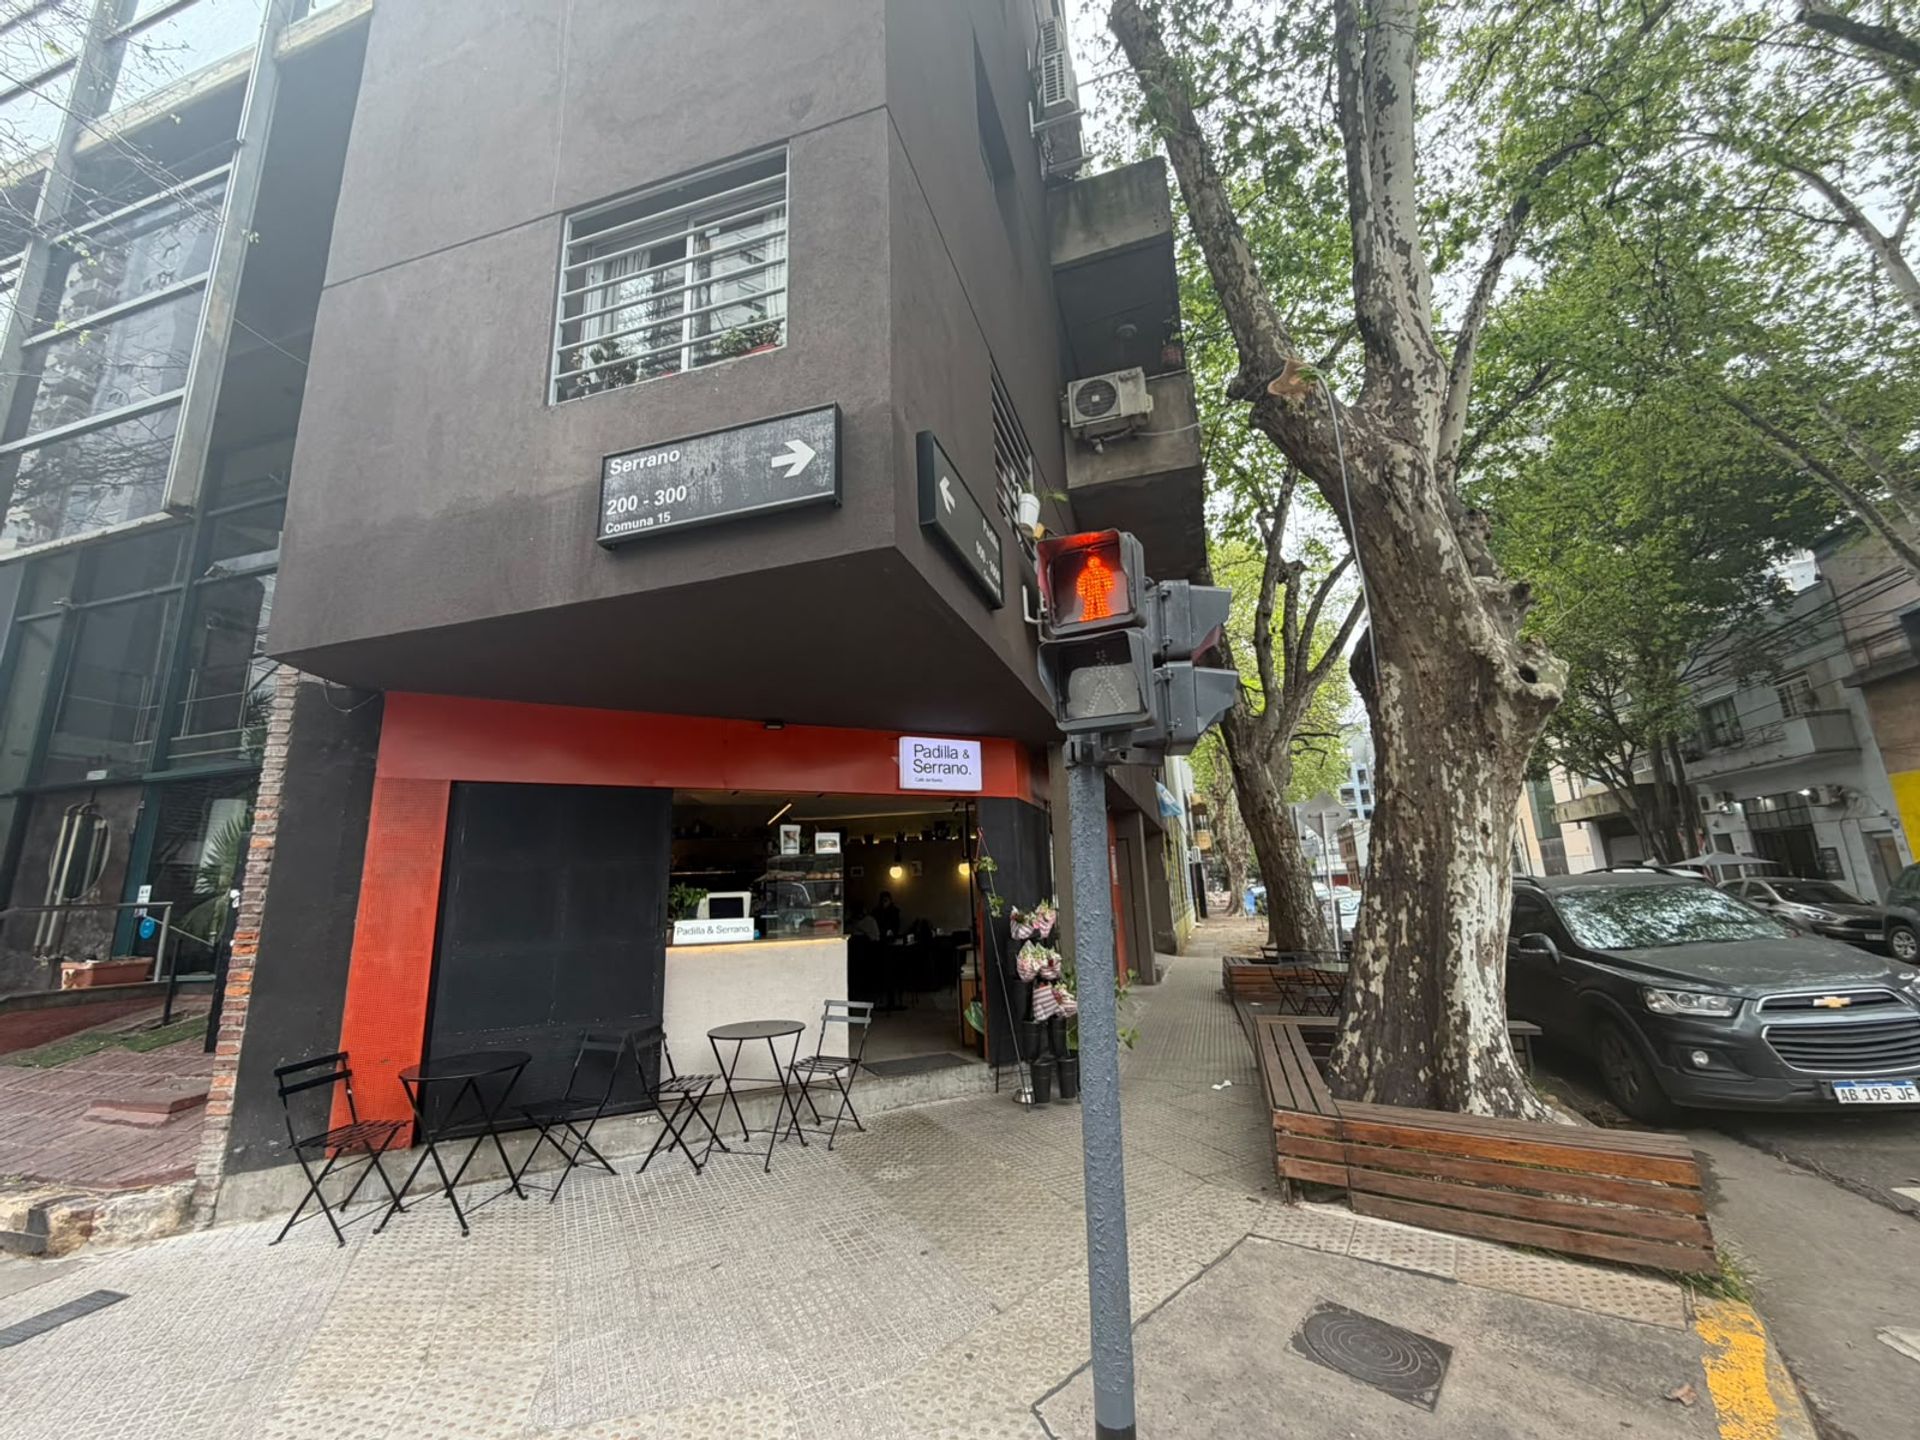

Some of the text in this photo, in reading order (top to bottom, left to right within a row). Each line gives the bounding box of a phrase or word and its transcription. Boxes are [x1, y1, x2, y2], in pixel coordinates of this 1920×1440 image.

[609, 450, 680, 475] Serrano
[606, 495, 638, 516] 200
[654, 485, 687, 507] 300
[605, 512, 671, 534] Comuna 15
[913, 743, 970, 760] Padilla &
[913, 758, 972, 775] Serrano.
[676, 926, 706, 936] Padilla
[707, 925, 714, 934] &
[1840, 1087, 1915, 1101] AB 195 JF
